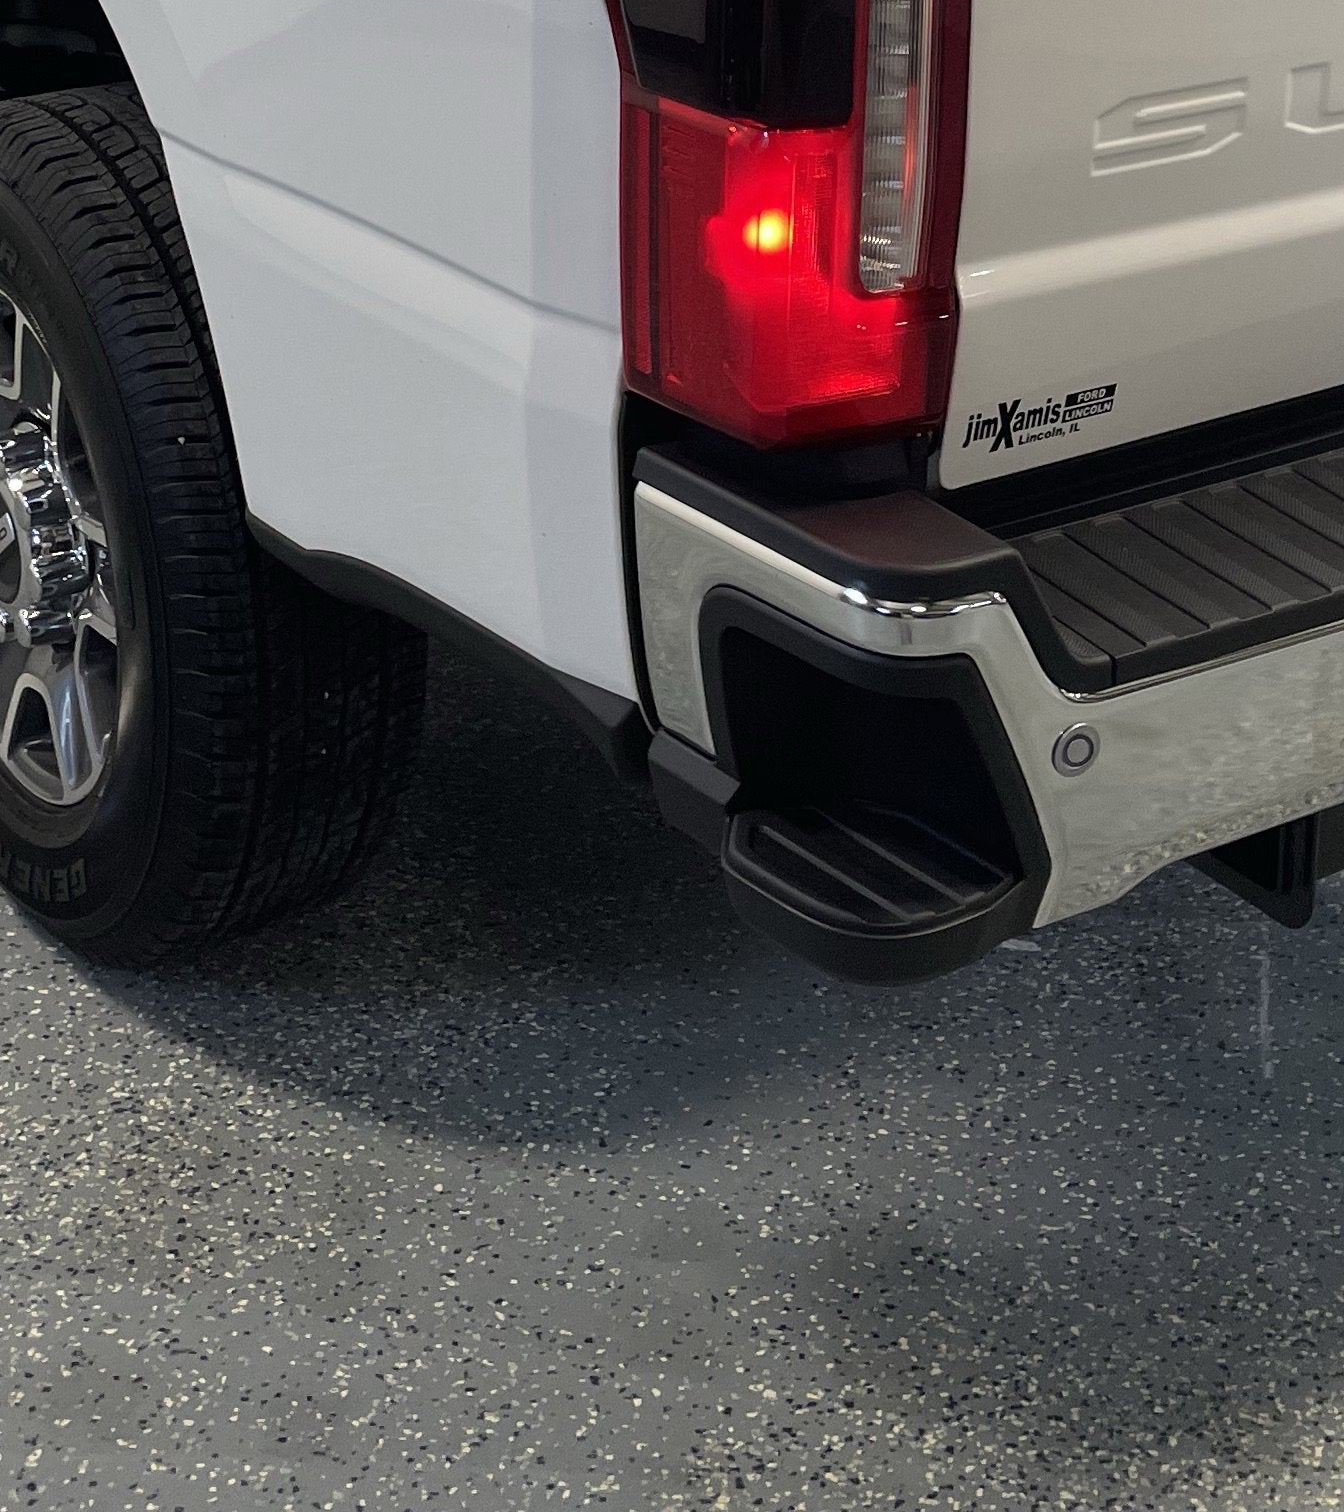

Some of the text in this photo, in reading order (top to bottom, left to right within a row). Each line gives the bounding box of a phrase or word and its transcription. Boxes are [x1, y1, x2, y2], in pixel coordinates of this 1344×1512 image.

[1076, 387, 1107, 404] FORD
[1064, 401, 1112, 421] LINCOLN
[1018, 422, 1081, 446] Lincoln, IL
